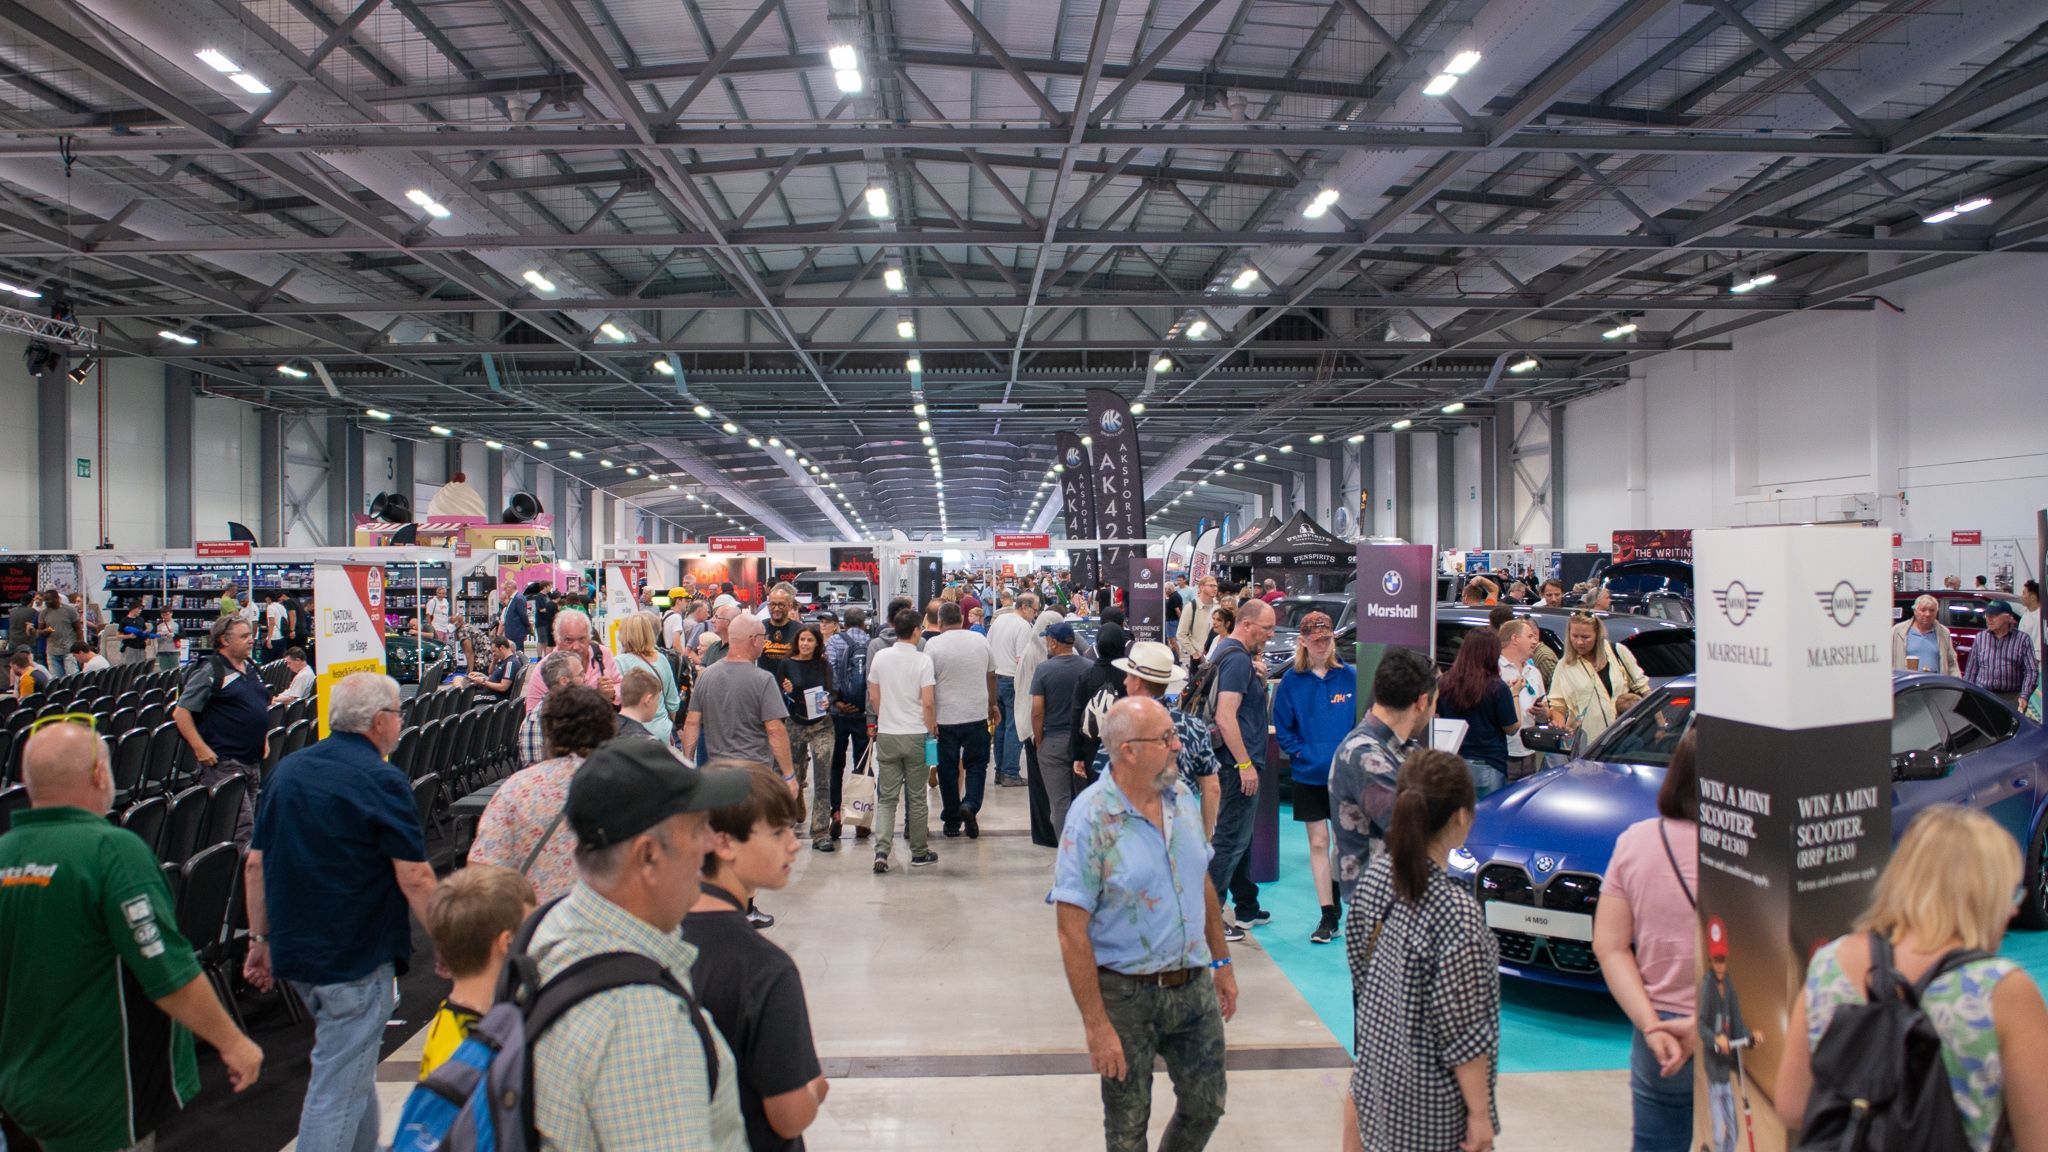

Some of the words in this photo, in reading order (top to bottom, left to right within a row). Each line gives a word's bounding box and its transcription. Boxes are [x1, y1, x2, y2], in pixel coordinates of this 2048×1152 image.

[1293, 553, 1336, 564] FENSPIRITS
[1634, 549, 1652, 558] THE
[1367, 603, 1418, 618] Marshall
[1728, 599, 1745, 609] MINI
[1835, 599, 1853, 609] MINI
[333, 609, 353, 621] NATIONAL
[333, 622, 359, 634] GEOGRAPHIC
[355, 640, 368, 653] Stage
[1707, 642, 1772, 667] MARSHALL
[1808, 645, 1879, 667] MARSHALL
[1700, 777, 1726, 803] WIN
[1727, 786, 1737, 807] A
[1738, 787, 1771, 816] MINI
[1797, 793, 1831, 819] WIN
[1832, 793, 1844, 814] A
[1845, 786, 1878, 813] MINI
[1700, 803, 1758, 839] SCOOTER.
[1797, 815, 1865, 848] SCOOTER.
[1797, 846, 1825, 870] (RRP
[1532, 917, 1549, 926] M50
